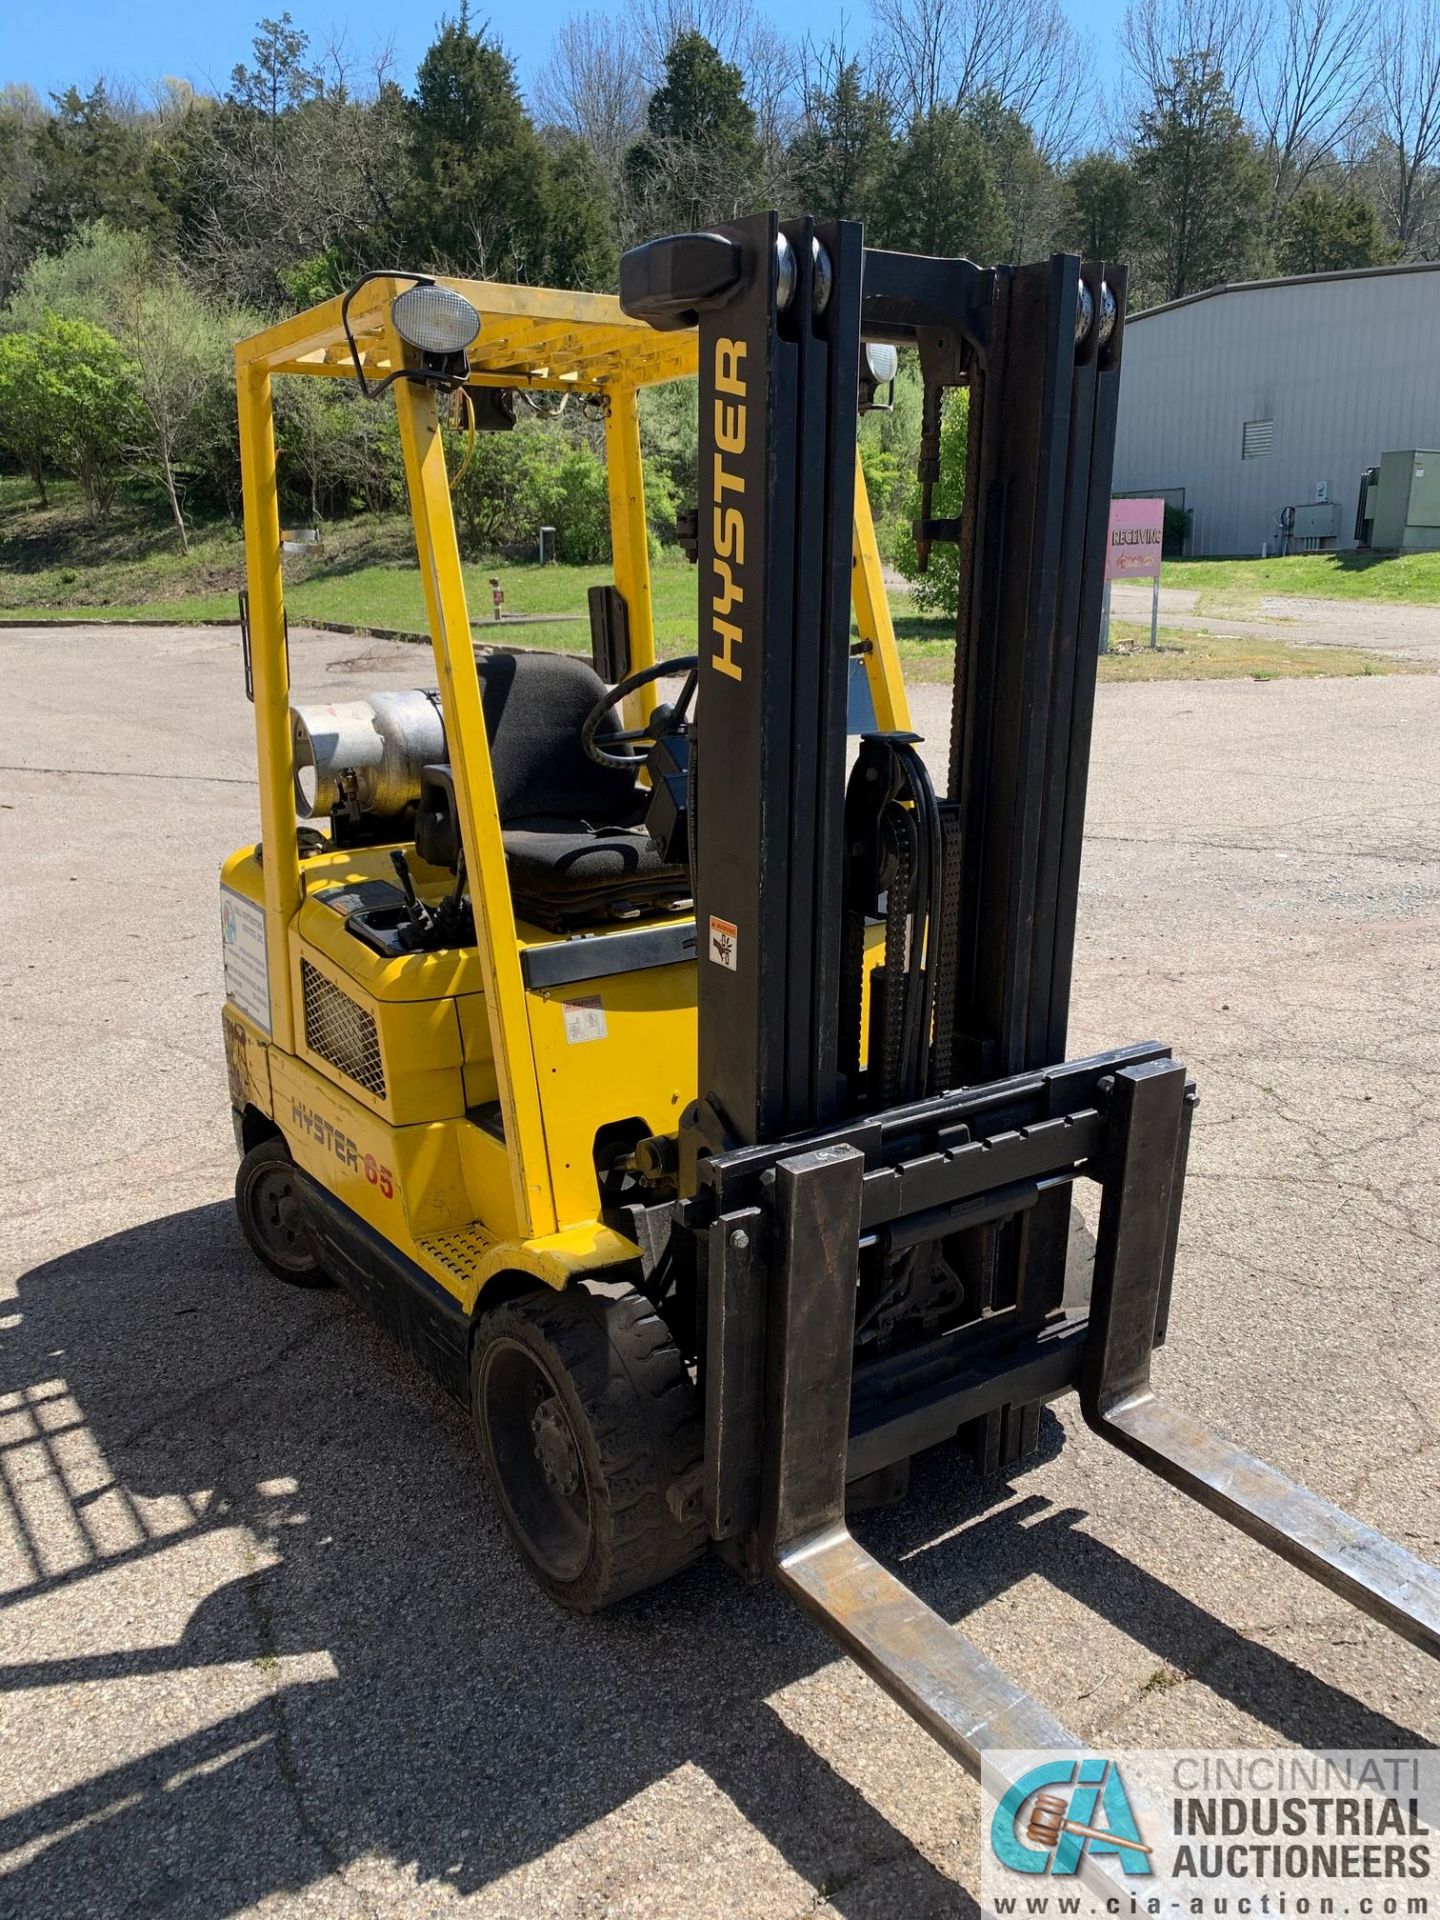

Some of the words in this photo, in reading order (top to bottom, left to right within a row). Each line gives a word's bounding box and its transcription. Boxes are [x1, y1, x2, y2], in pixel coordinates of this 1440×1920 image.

[711, 337, 748, 682] HYSTER
[1111, 529, 1161, 546] RECEIVING
[291, 1096, 358, 1173] HYSTER
[364, 1153, 393, 1199] 65
